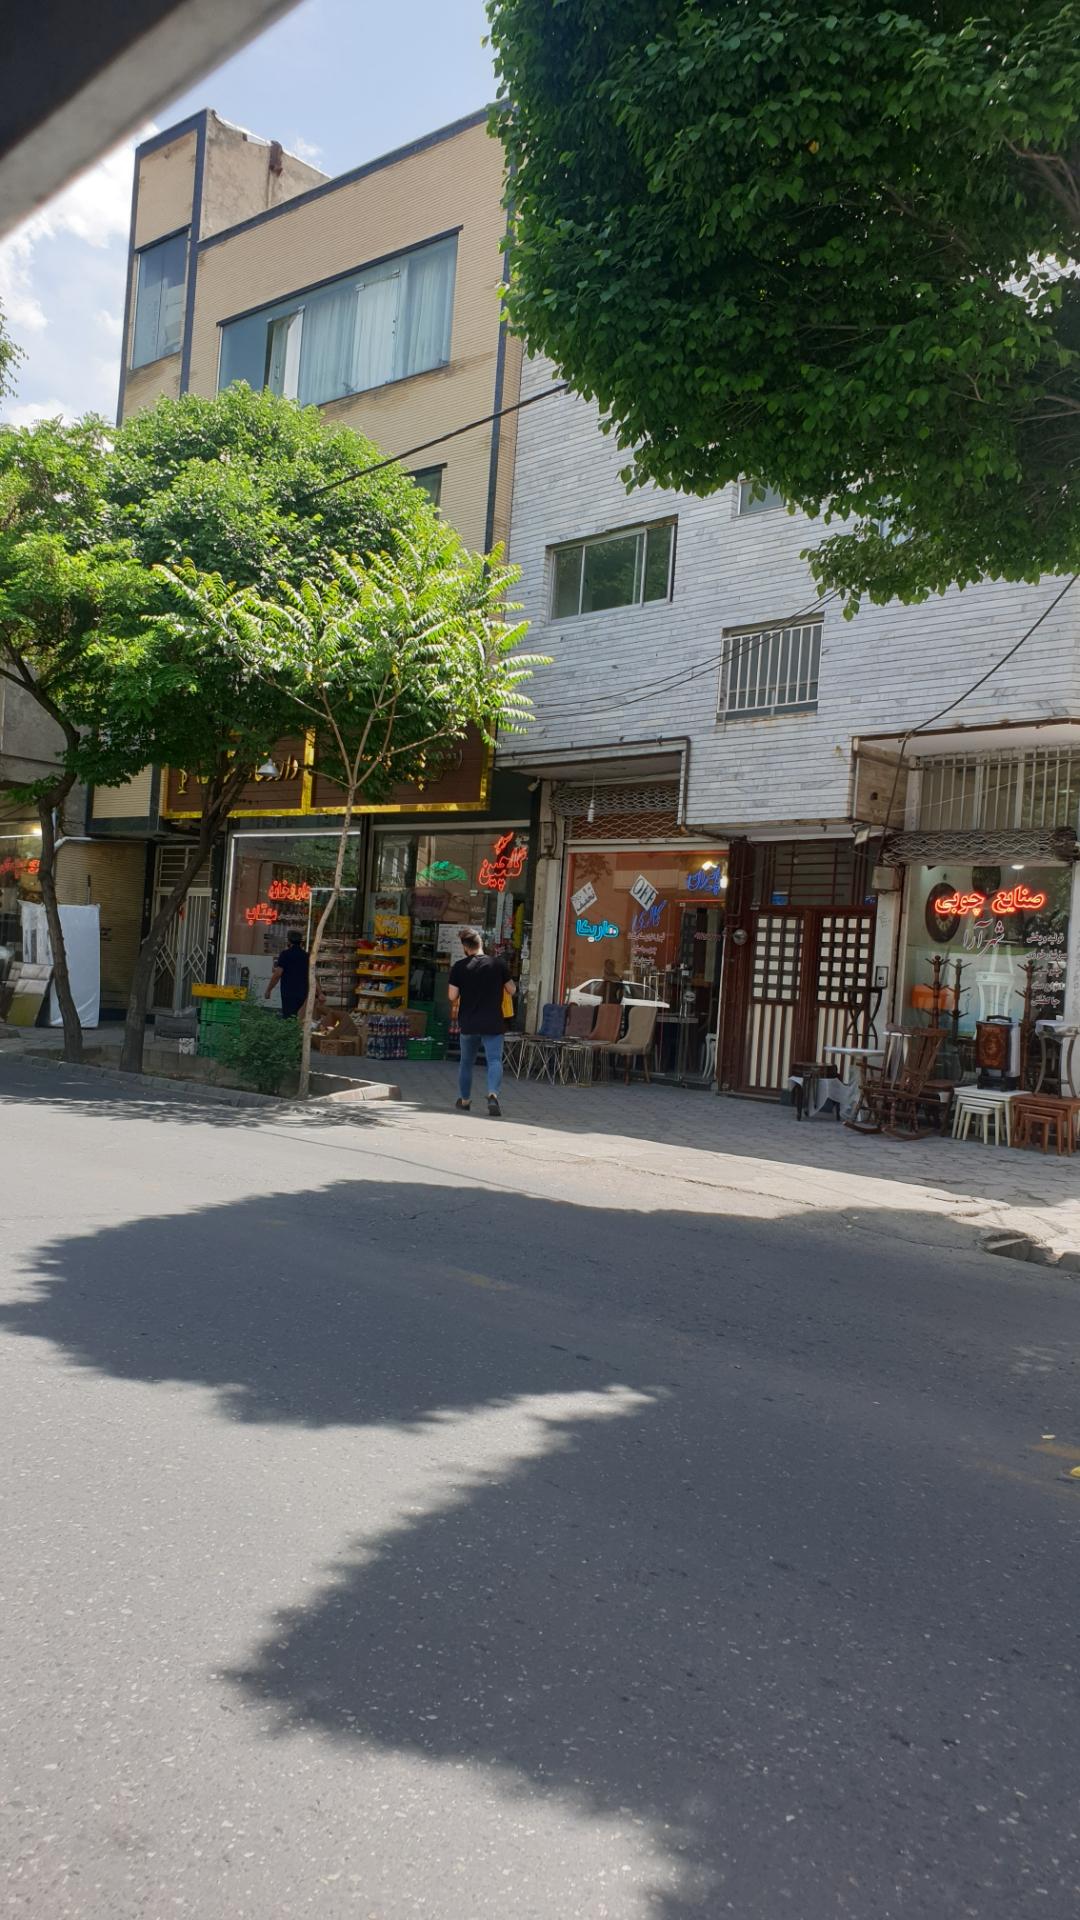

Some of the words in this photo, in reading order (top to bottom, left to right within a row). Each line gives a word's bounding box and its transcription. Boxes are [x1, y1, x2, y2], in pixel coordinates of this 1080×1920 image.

[268, 880, 311, 900] داروخانه
[633, 877, 659, 907] OFF
[991, 886, 1046, 914] صنایع
[935, 892, 985, 916] چوبی
